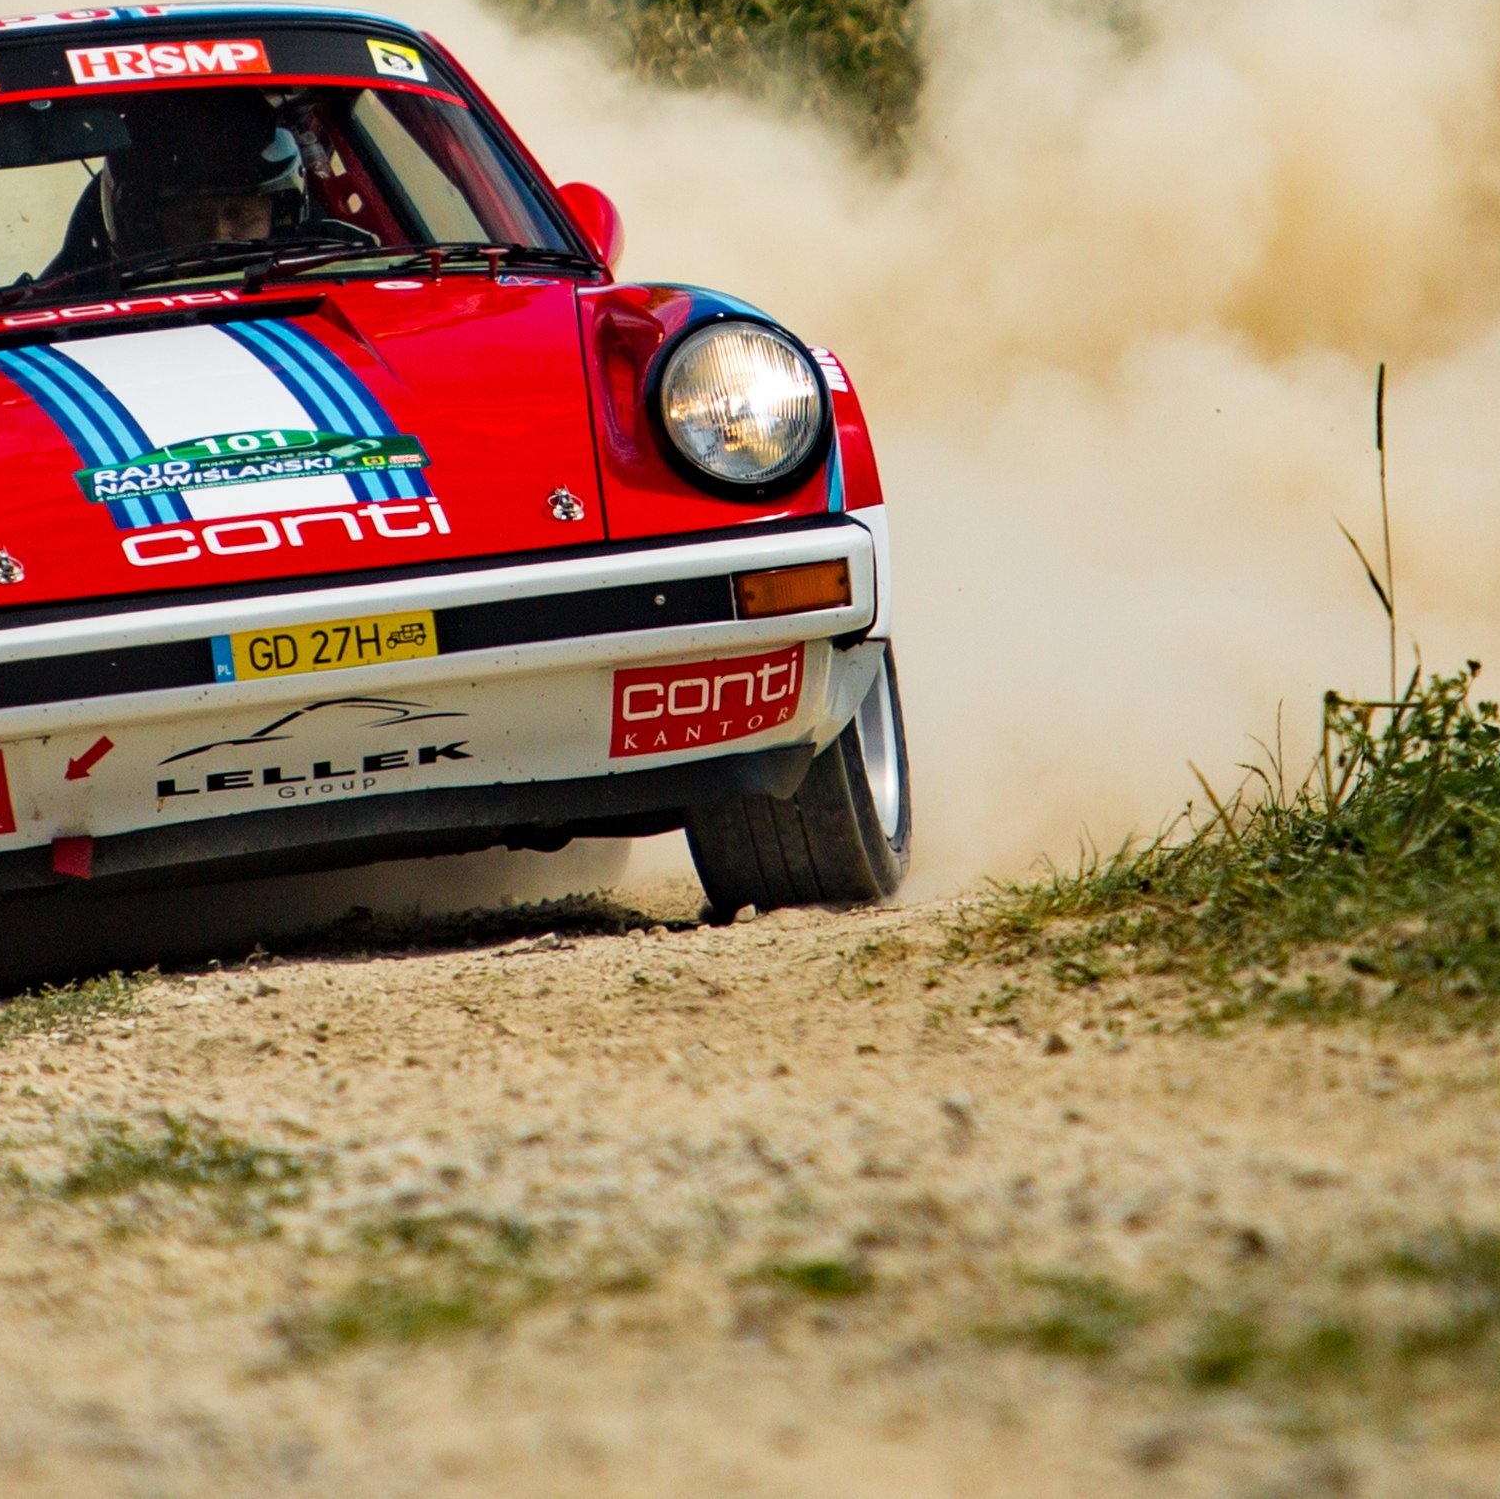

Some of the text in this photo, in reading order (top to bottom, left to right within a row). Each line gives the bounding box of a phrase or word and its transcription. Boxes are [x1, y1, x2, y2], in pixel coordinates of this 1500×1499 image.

[76, 41, 258, 79] HRSMP
[2, 289, 239, 327] conti
[194, 430, 288, 455] 101
[93, 461, 191, 485] RAJD
[94, 456, 334, 498] NADWIŚLAŃSKI
[121, 496, 452, 568] conti
[249, 623, 382, 672] GD 27H
[216, 664, 232, 676] PL
[622, 651, 797, 722] conti
[624, 707, 789, 750] KANTOR
[156, 740, 474, 798] LELLEK
[277, 777, 376, 799] Group
